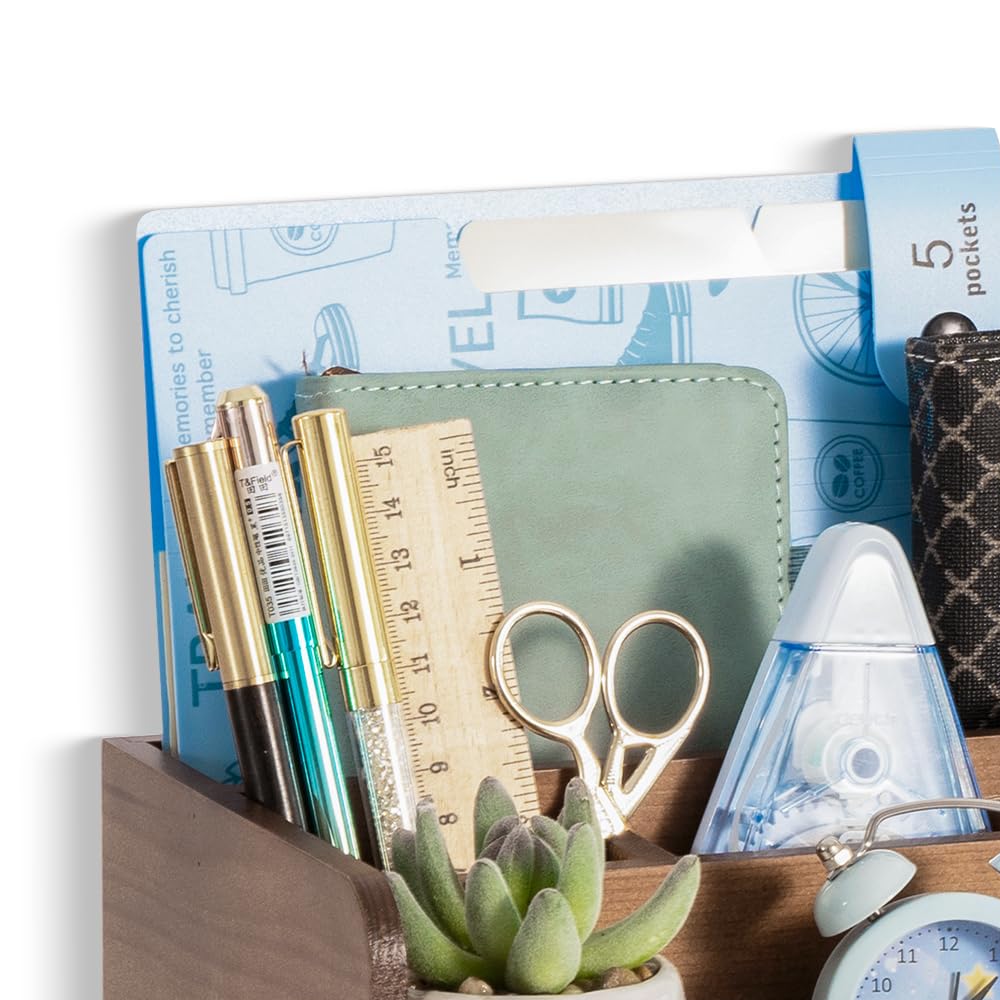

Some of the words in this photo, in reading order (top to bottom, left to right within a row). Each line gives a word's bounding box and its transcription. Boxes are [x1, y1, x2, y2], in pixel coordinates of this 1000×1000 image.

[445, 222, 461, 279] Mem
[911, 239, 954, 269] 5
[957, 202, 987, 296] pockets
[158, 249, 182, 325] cherish
[168, 332, 184, 354] to
[169, 361, 192, 446] emories
[196, 348, 217, 437] member
[373, 445, 395, 468] 15
[439, 448, 461, 489] inch
[852, 449, 865, 498] COFFEE
[381, 496, 404, 520] 14
[391, 547, 413, 573] 13
[400, 599, 422, 624] 12
[410, 652, 431, 674] 11
[418, 702, 441, 728] 10
[428, 760, 450, 775] 9
[438, 812, 459, 827] 8
[896, 947, 918, 965] 11
[938, 935, 960, 953] 12
[988, 947, 999, 963] 1
[871, 976, 893, 994] 10
